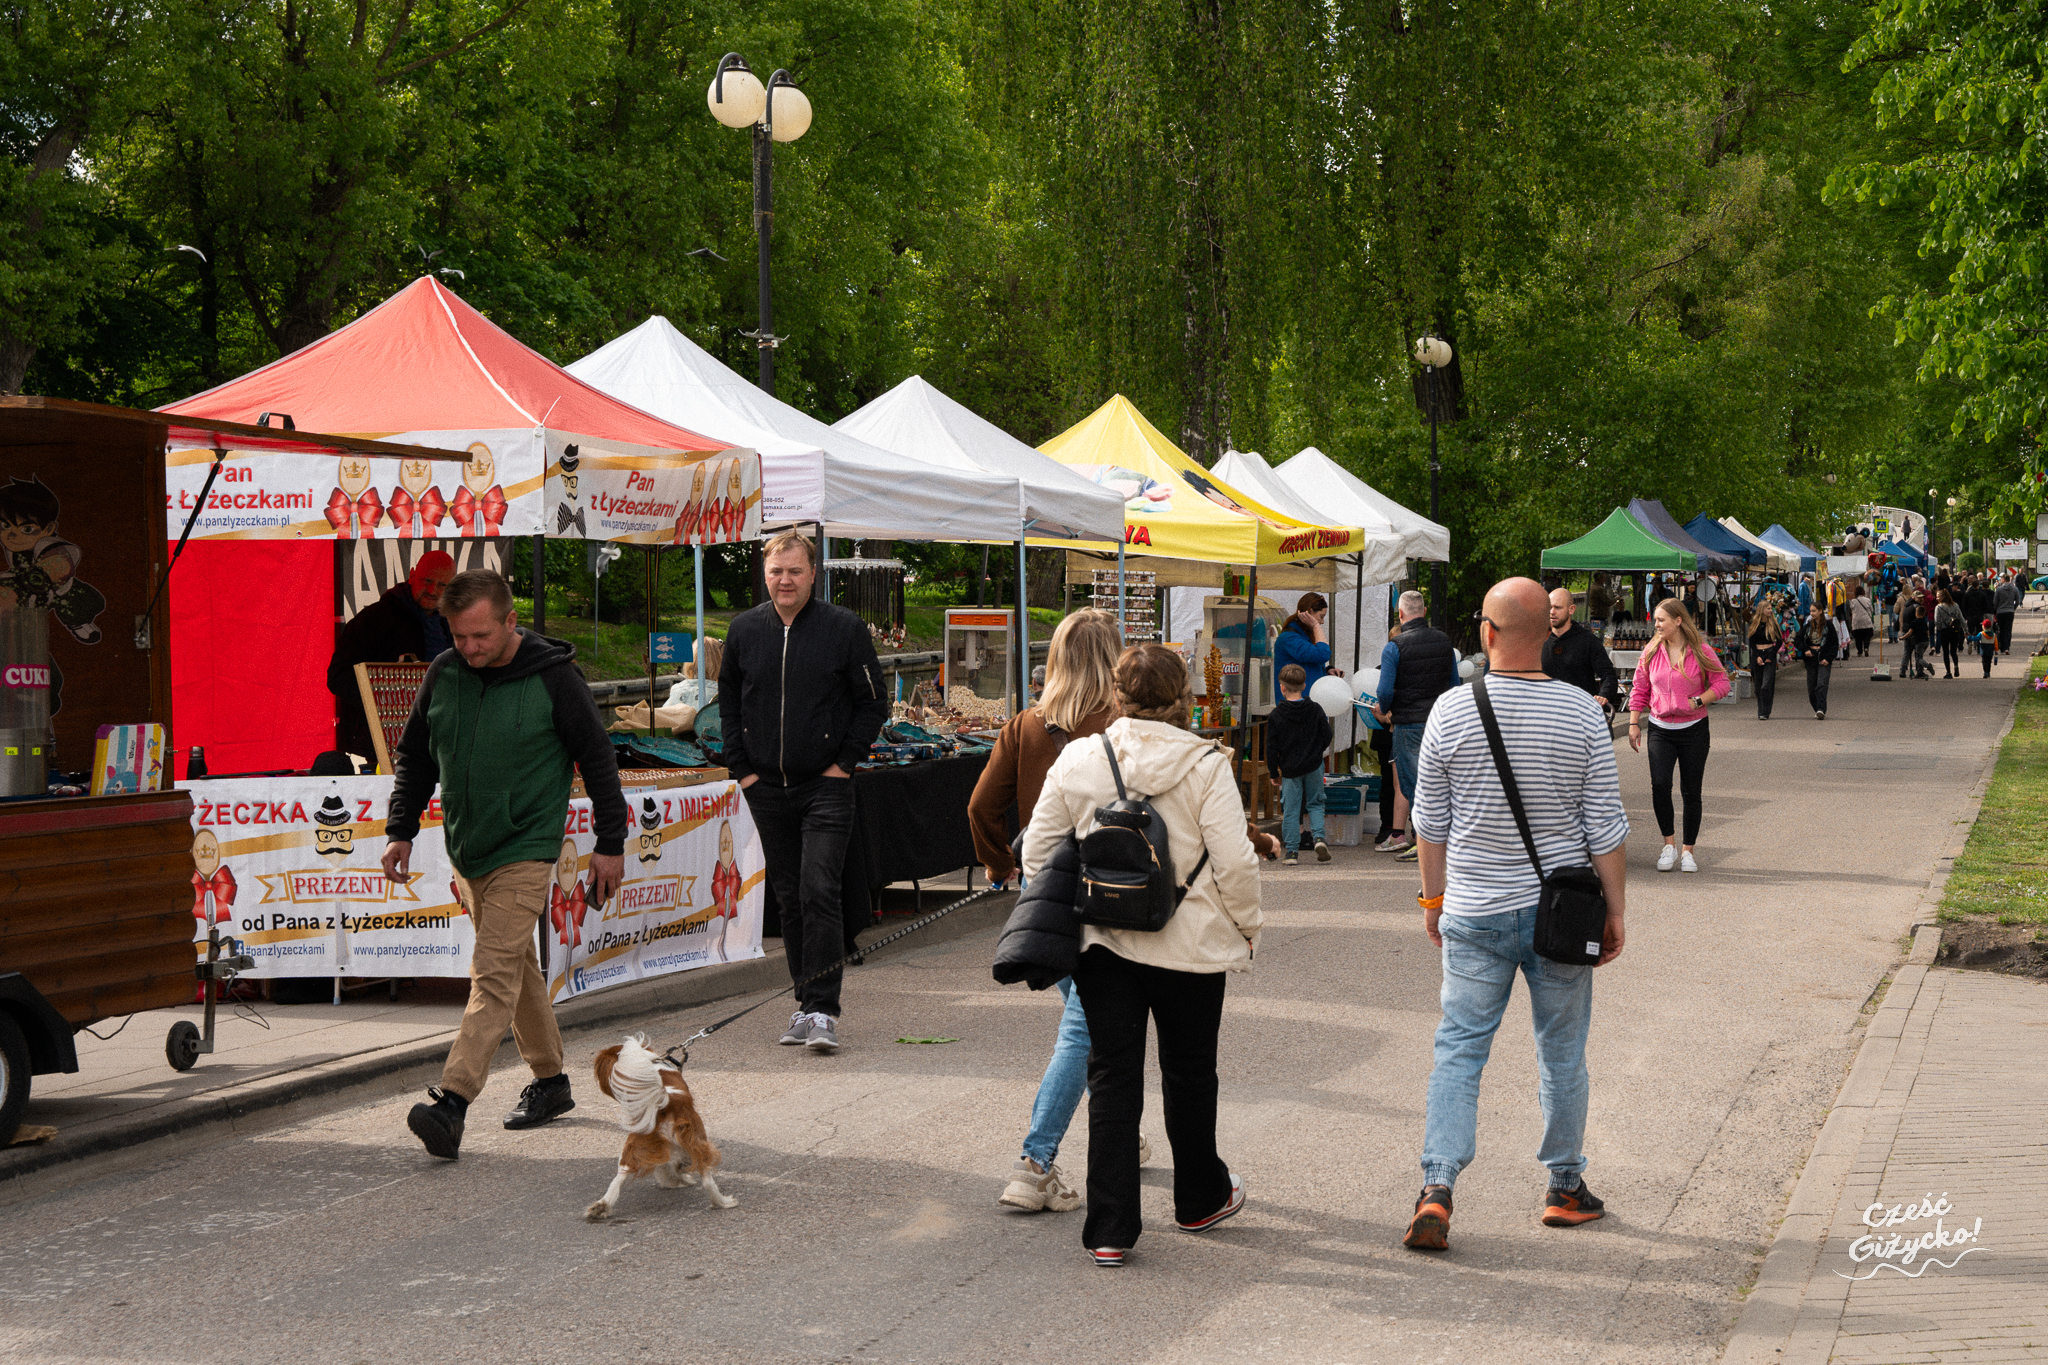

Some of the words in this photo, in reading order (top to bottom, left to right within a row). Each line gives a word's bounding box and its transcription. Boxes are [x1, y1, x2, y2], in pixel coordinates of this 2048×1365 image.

[626, 470, 655, 492] Pan
[591, 495, 598, 511] z
[600, 491, 680, 518] Łyżeczkami
[181, 514, 290, 529] ww.panzlyzeczkami.pl
[193, 799, 310, 826] ŻECZKA
[357, 800, 373, 822] Z
[663, 800, 674, 824] Z
[680, 793, 741, 822] IMIENIEM
[294, 875, 387, 895] PREZENT
[621, 882, 677, 909] PREZENT
[242, 914, 265, 931] od
[272, 913, 320, 930] Pana
[326, 917, 336, 930] z
[340, 911, 451, 933] Łyżeczkami
[588, 933, 602, 955] od
[602, 931, 631, 950] Pana
[633, 930, 641, 945] z
[642, 914, 710, 946] Łyżeczkami
[353, 943, 461, 959] www.panzlyzeczkami.pl
